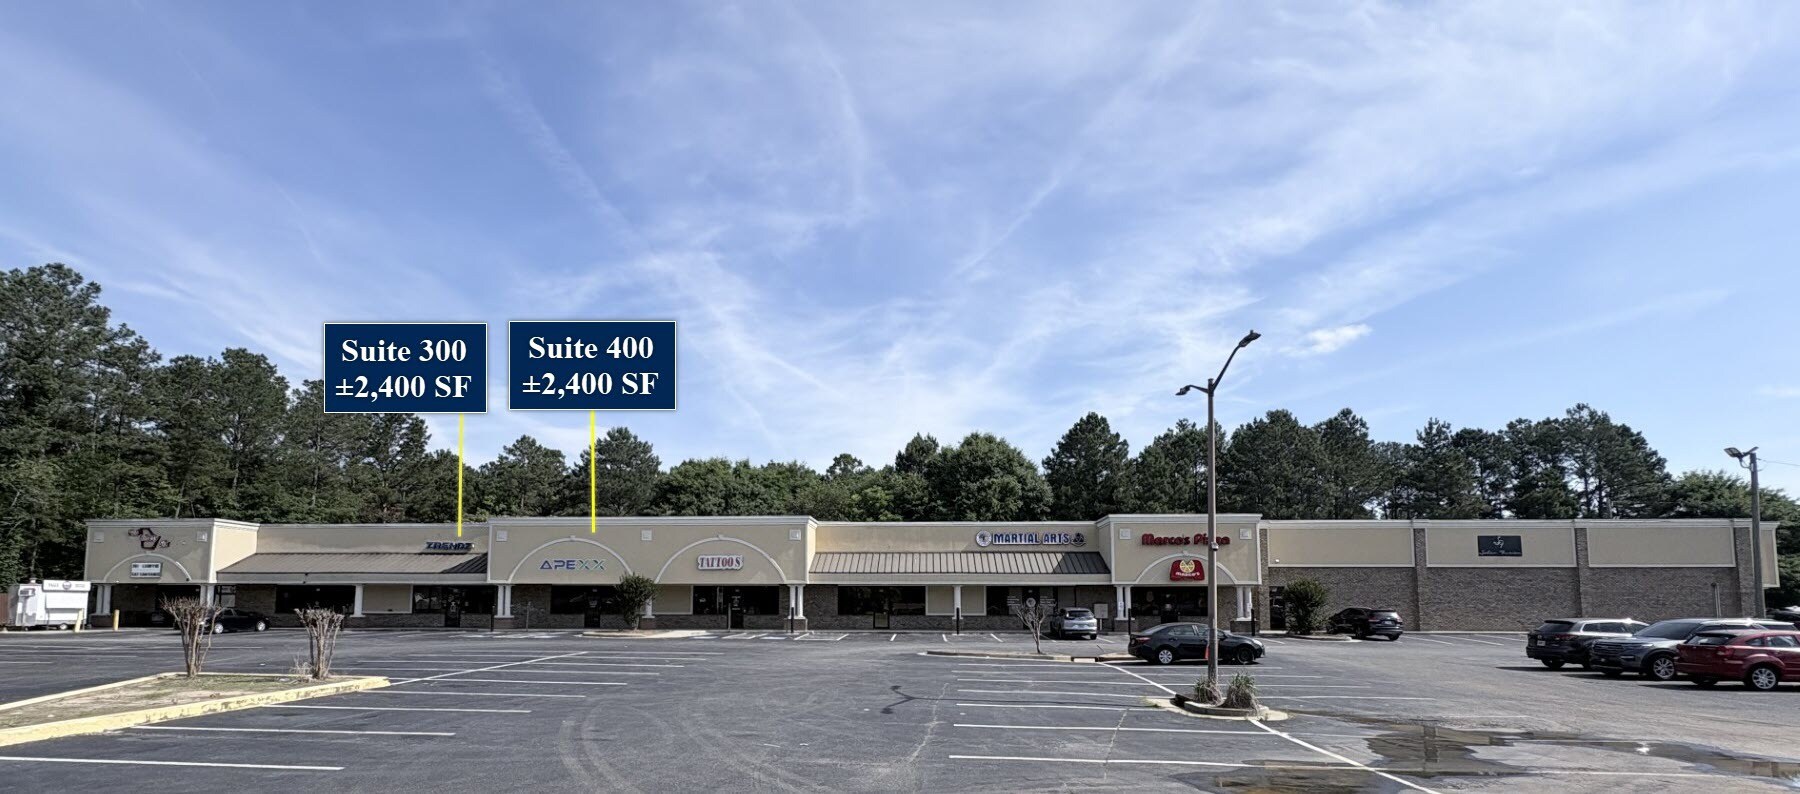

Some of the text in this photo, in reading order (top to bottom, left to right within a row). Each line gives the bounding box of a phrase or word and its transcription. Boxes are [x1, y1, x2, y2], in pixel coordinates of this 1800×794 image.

[993, 532, 1069, 544] MARTIAL ARTS
[539, 559, 605, 570] APEXX
